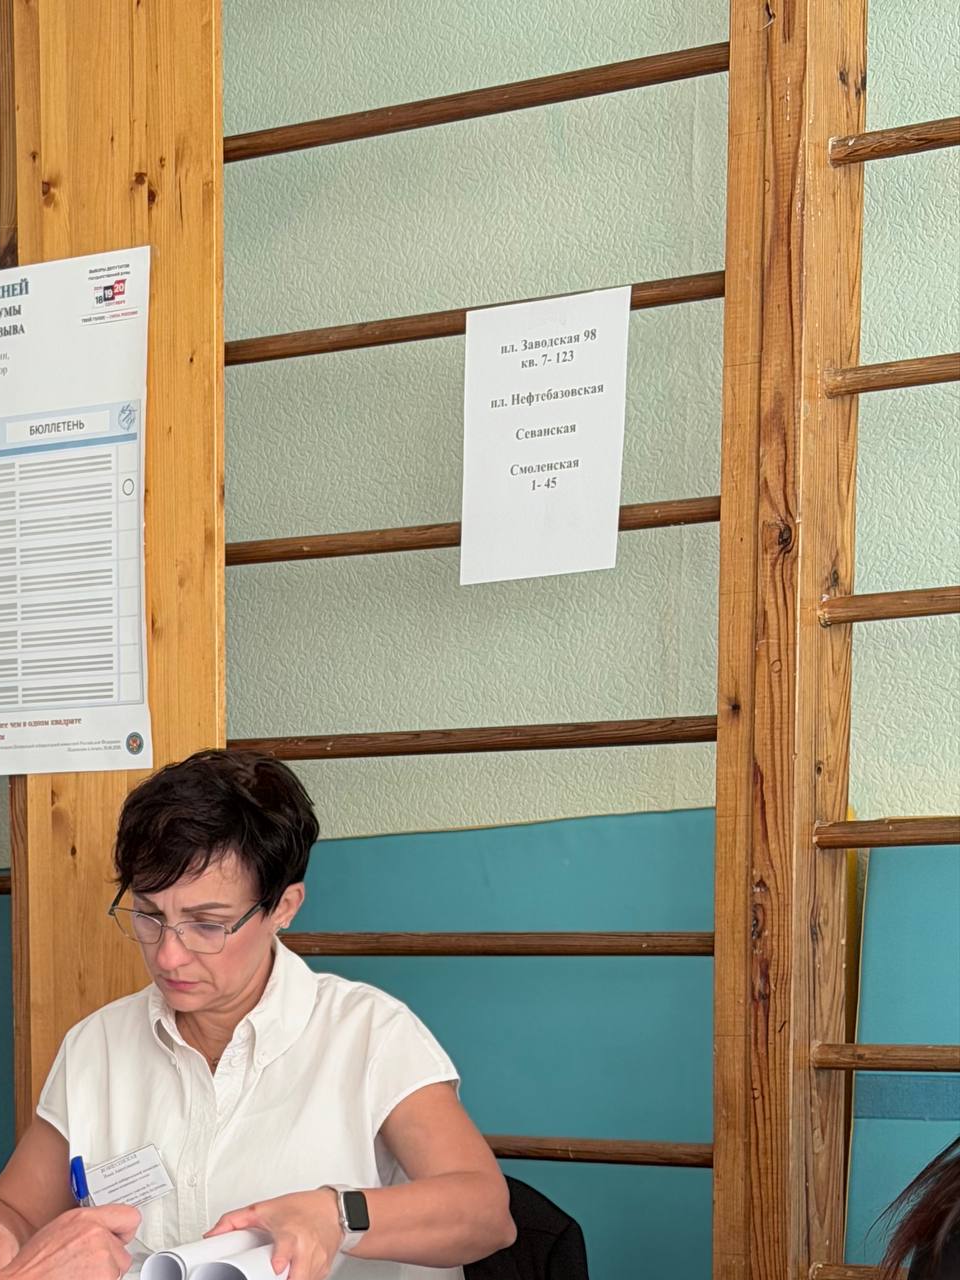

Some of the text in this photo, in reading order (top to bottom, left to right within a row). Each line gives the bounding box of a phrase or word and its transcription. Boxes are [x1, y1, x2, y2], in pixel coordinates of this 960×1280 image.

[500, 328, 597, 354] пл. Заводская 98
[521, 350, 574, 368] кв. 7- 123
[490, 384, 604, 408] пл. Нефтебазовская
[30, 420, 85, 436] БЮЛЛЕТЕНЬ
[515, 424, 576, 440] Севанская
[510, 459, 579, 476] Смоленская
[544, 477, 557, 488] 45
